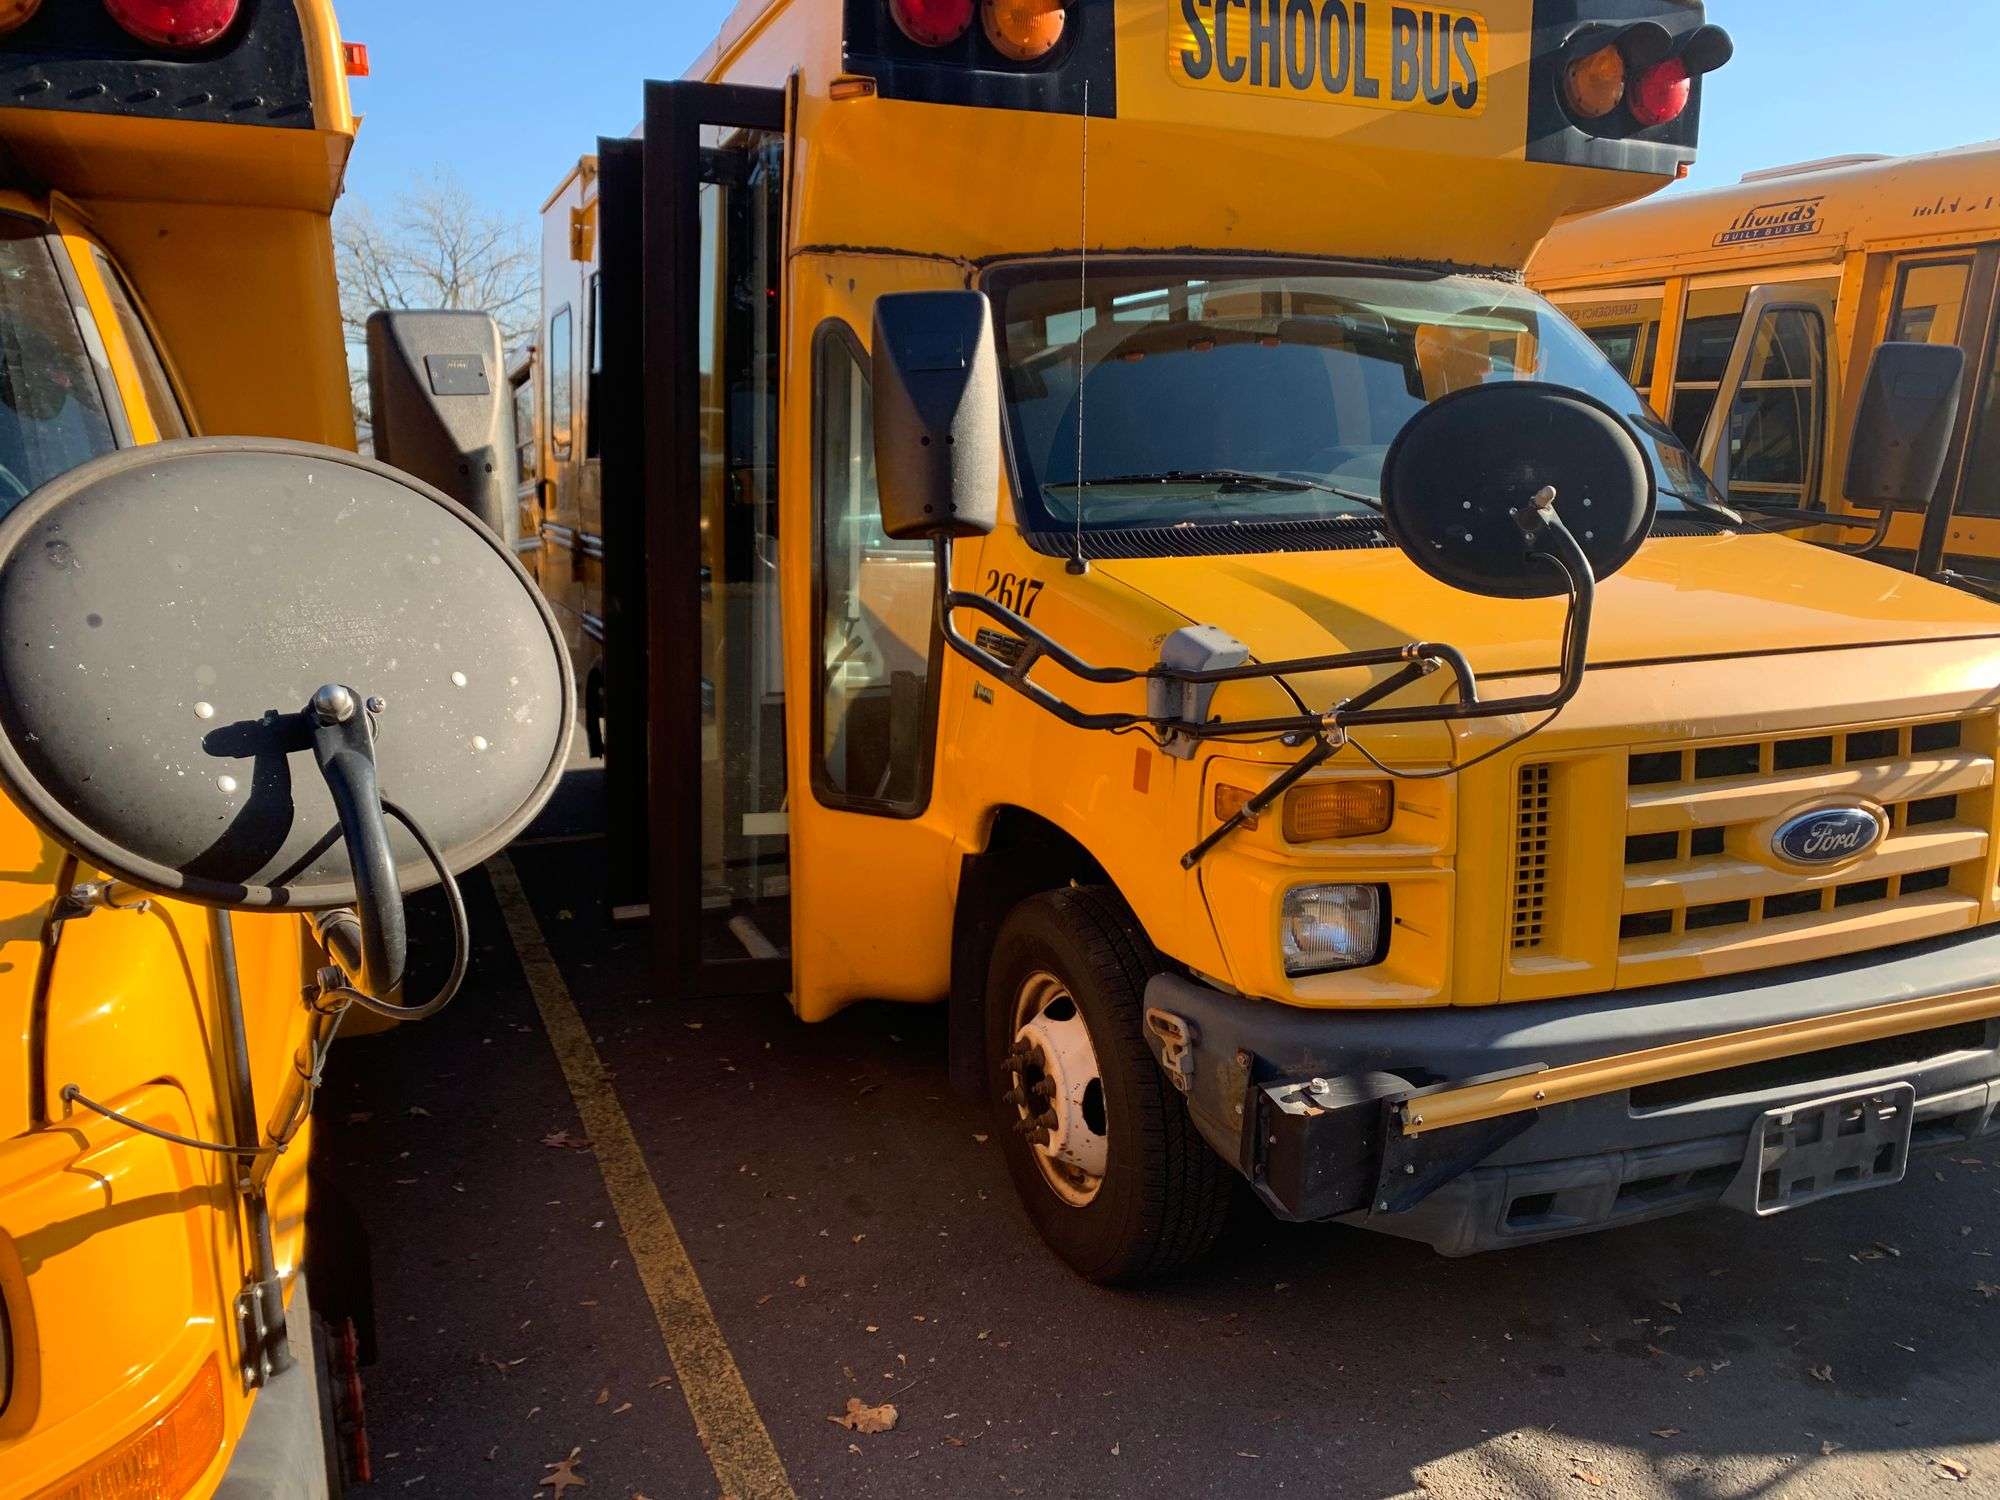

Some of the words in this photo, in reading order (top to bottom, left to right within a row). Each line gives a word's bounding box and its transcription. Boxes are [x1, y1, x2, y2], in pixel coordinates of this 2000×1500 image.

[1180, 0, 1380, 99] SCHOOL
[1391, 6, 1479, 110] BUS
[1723, 230, 1759, 242] BUILT
[1764, 222, 1811, 237] BUSES
[985, 569, 1045, 619] 2617
[1803, 818, 1862, 854] Ford
